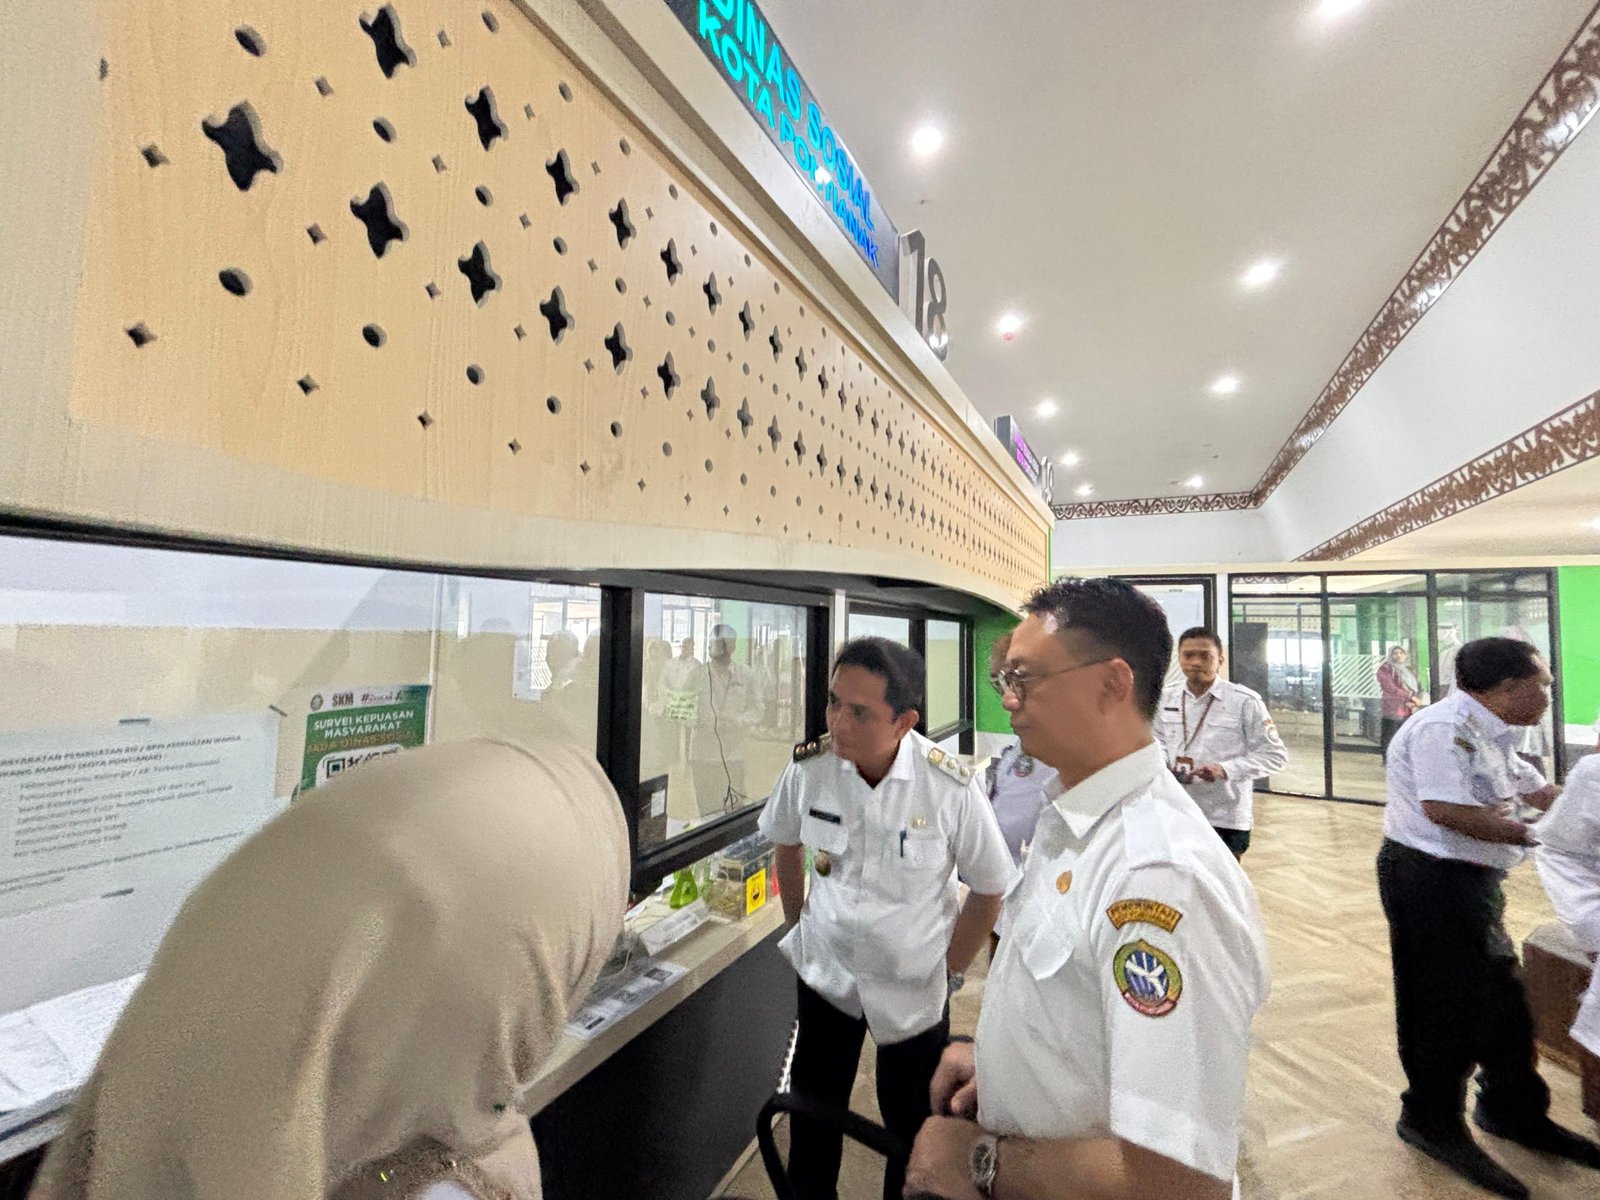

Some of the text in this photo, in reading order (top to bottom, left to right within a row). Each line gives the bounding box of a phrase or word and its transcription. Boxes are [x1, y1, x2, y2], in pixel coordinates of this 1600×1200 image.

[699, 0, 775, 131] KOTA
[711, 0, 875, 233] INAS SOSIAL
[901, 229, 948, 362] 18
[313, 709, 414, 731] SURVEI KEPUASAN
[324, 721, 401, 738] MASYARAKAT
[331, 692, 354, 707] SKM
